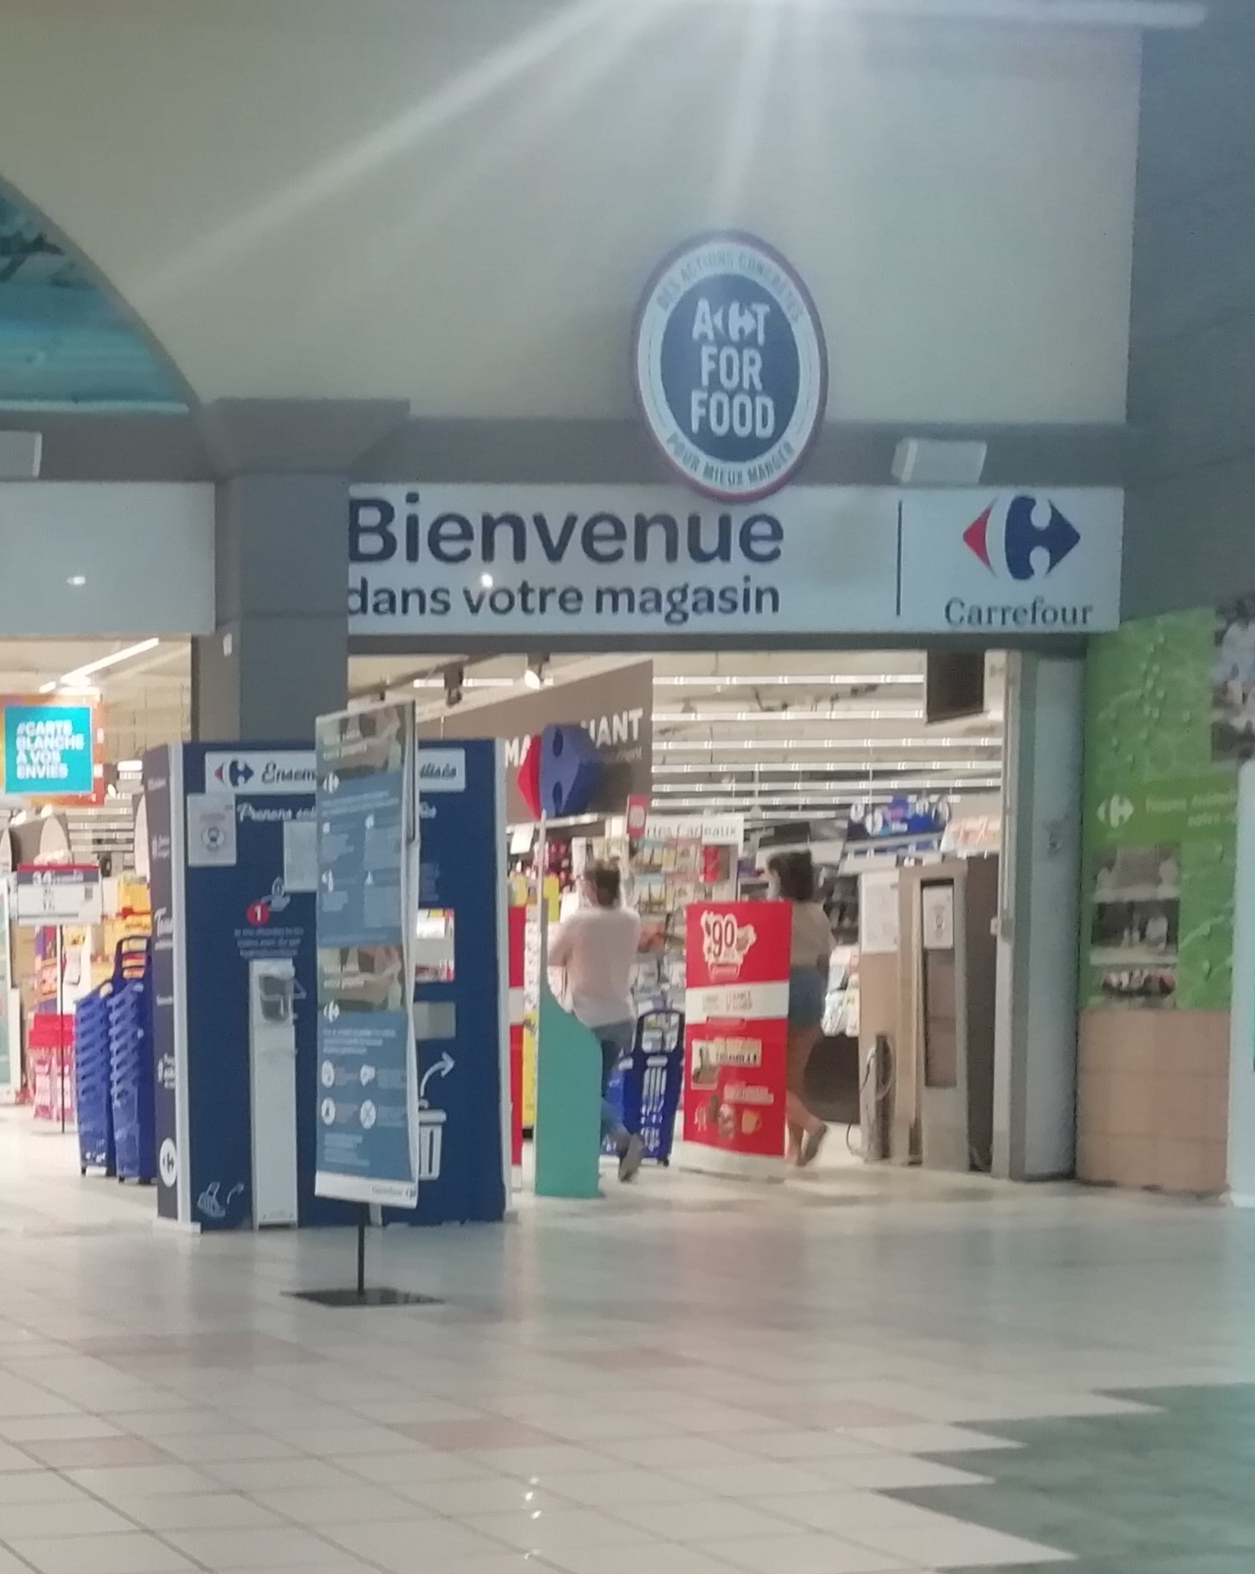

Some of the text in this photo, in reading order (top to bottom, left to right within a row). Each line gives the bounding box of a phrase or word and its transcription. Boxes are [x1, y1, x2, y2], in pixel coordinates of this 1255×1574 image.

[700, 345, 763, 391] FOR
[691, 389, 776, 439] FOOD
[665, 431, 795, 488] POUR MIEUX MANGER
[349, 491, 785, 564] Bienvenue
[348, 575, 781, 626] dans votre magasin
[945, 595, 1093, 628] Carrefour
[16, 734, 84, 751] BLANCHE
[30, 749, 62, 765] VOS
[16, 763, 69, 779] ENVIES
[254, 905, 262, 921] 1
